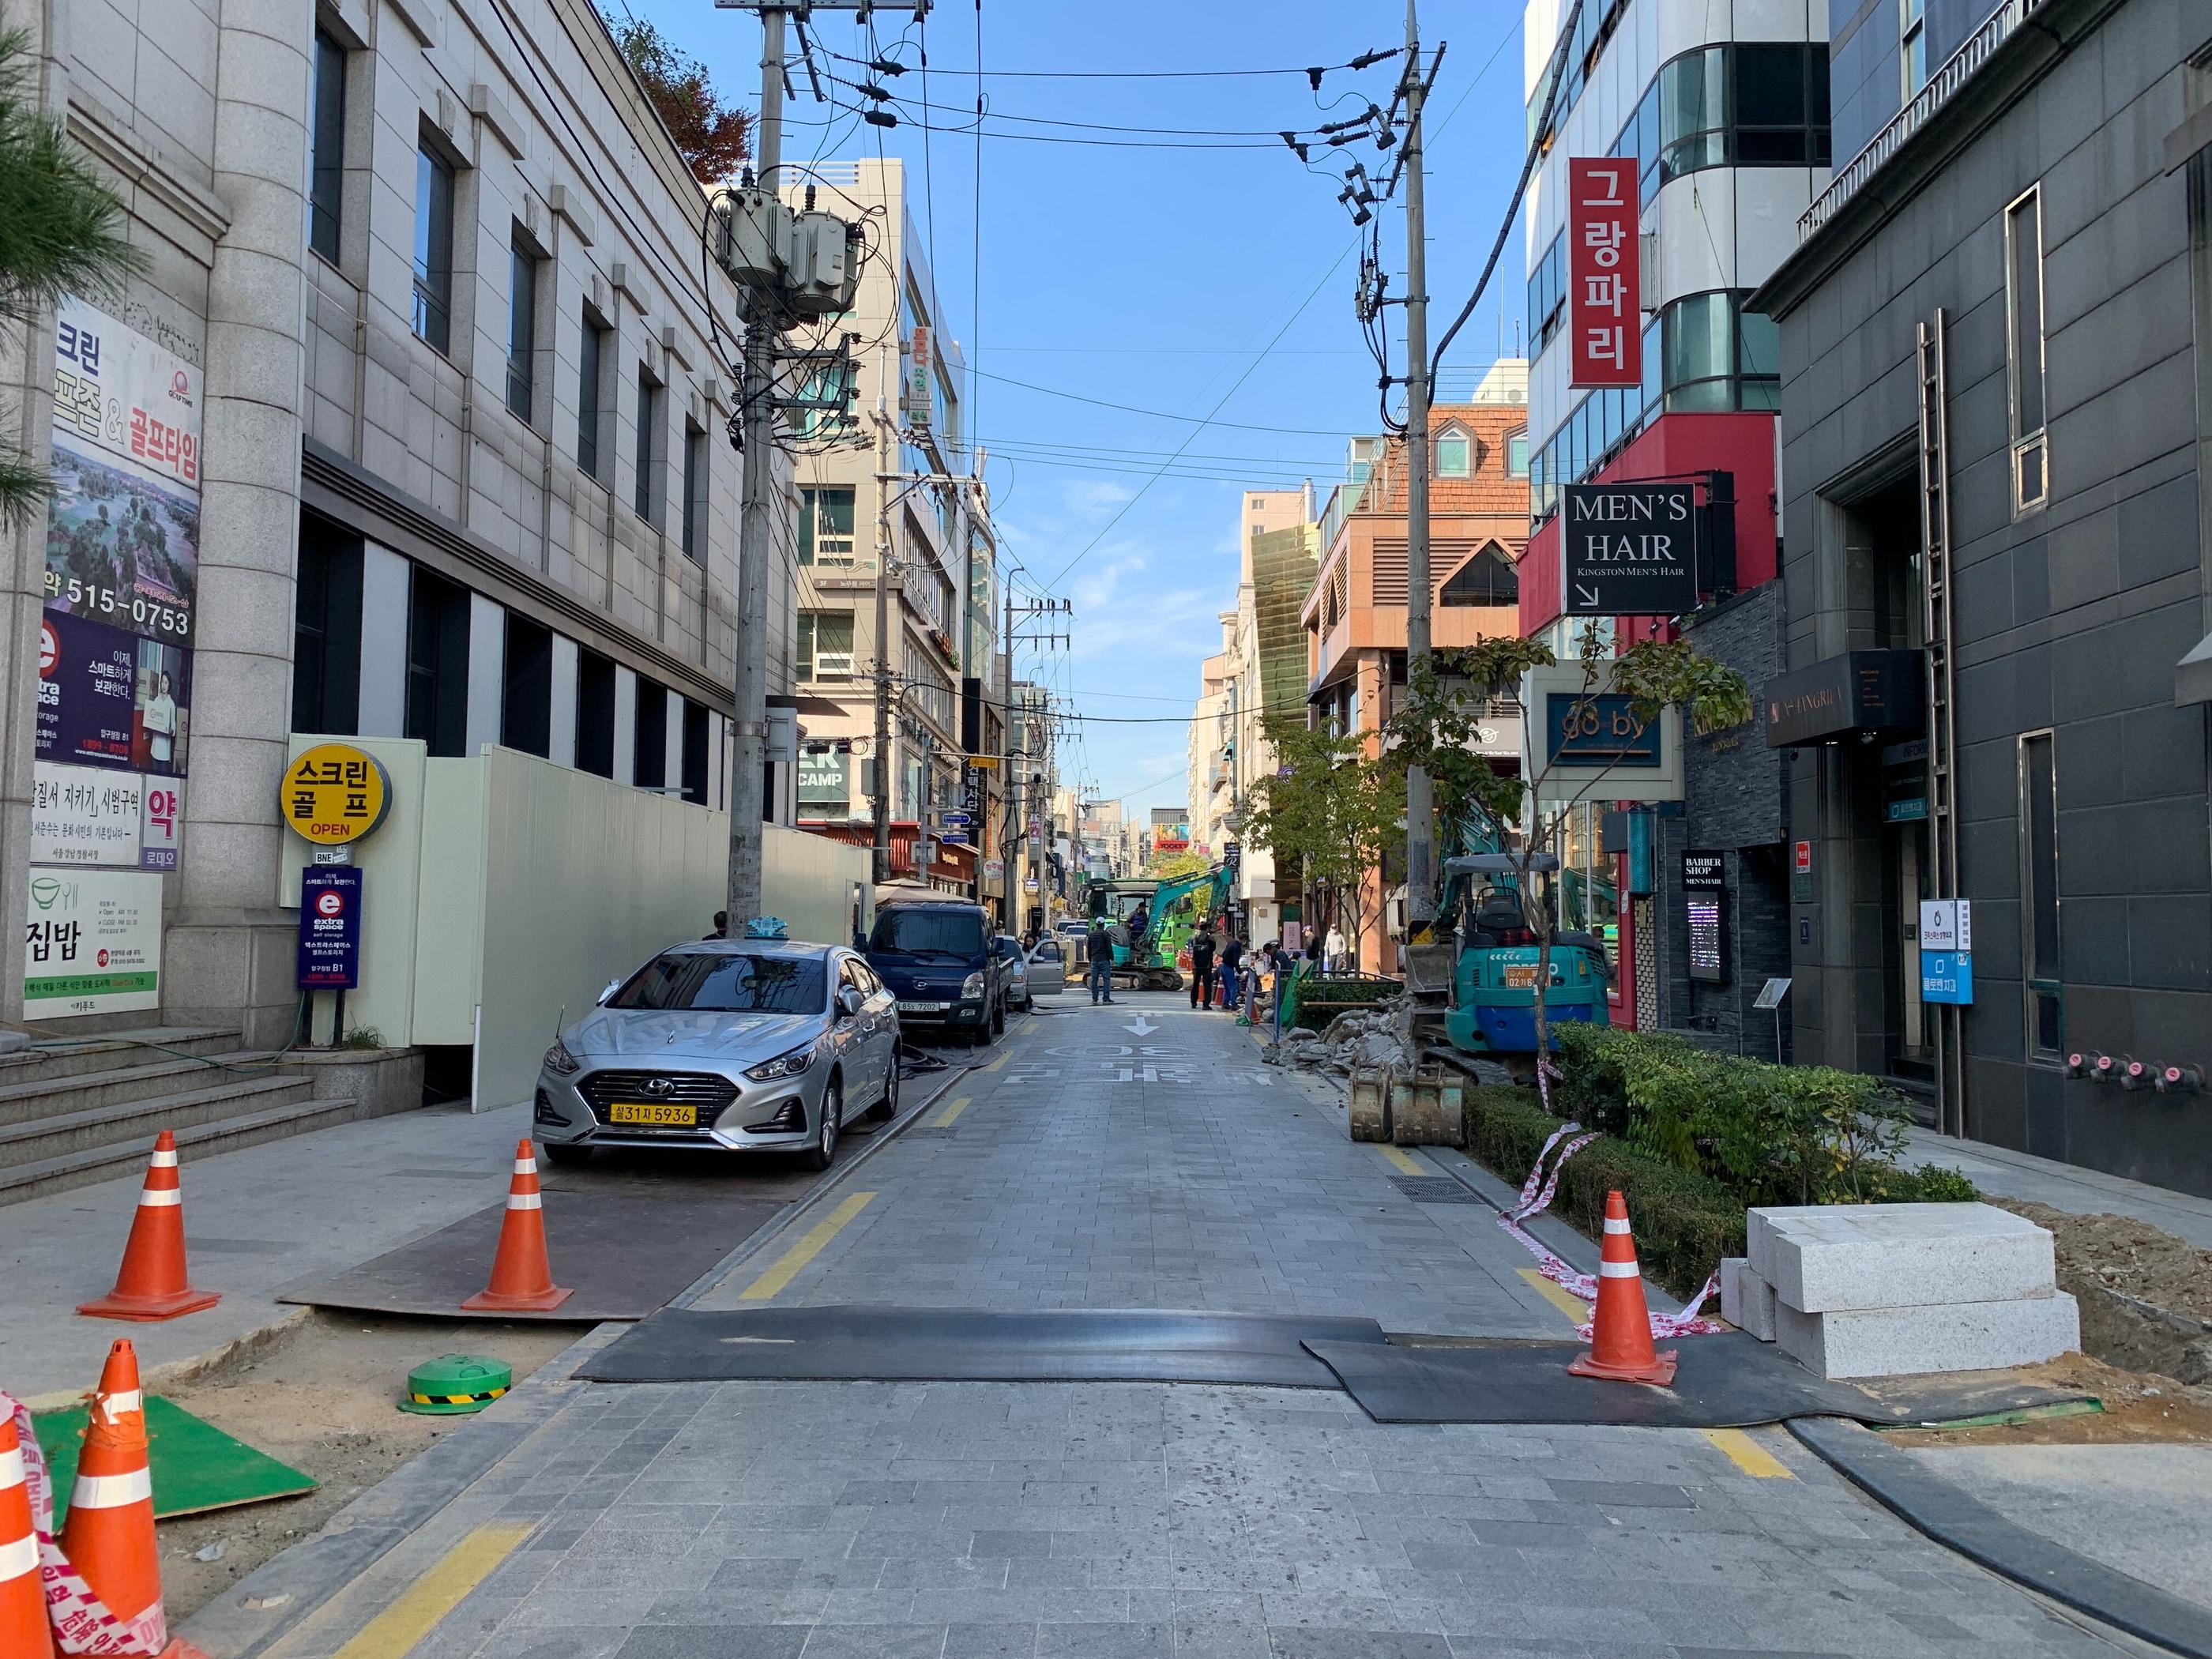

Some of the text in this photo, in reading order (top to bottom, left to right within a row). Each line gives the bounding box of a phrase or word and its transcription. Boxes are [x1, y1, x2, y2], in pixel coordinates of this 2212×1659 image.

[1582, 171, 1627, 370] 그랑파리
[105, 398, 124, 445] &
[130, 406, 197, 481] 골프타임
[1573, 494, 1687, 521] MEN’S
[1585, 535, 1676, 561] HAIR
[1661, 567, 1684, 576] HAIR
[66, 578, 189, 635] 515-0753
[88, 660, 131, 683] 스마트하게
[94, 679, 130, 700] 보관한다.
[1561, 711, 1645, 739] go by
[295, 760, 367, 788] 스크린
[799, 773, 842, 786] CAMP
[101, 788, 138, 816] 시범구역
[149, 790, 177, 839] 약
[310, 823, 349, 835] OPEN
[52, 848, 98, 860] 서울강남경찰서장
[146, 852, 174, 867] 로데오
[317, 853, 332, 863] BNE
[1686, 858, 1721, 867] BARBER
[26, 920, 81, 962] 집밥
[655, 1108, 690, 1122] 5936
